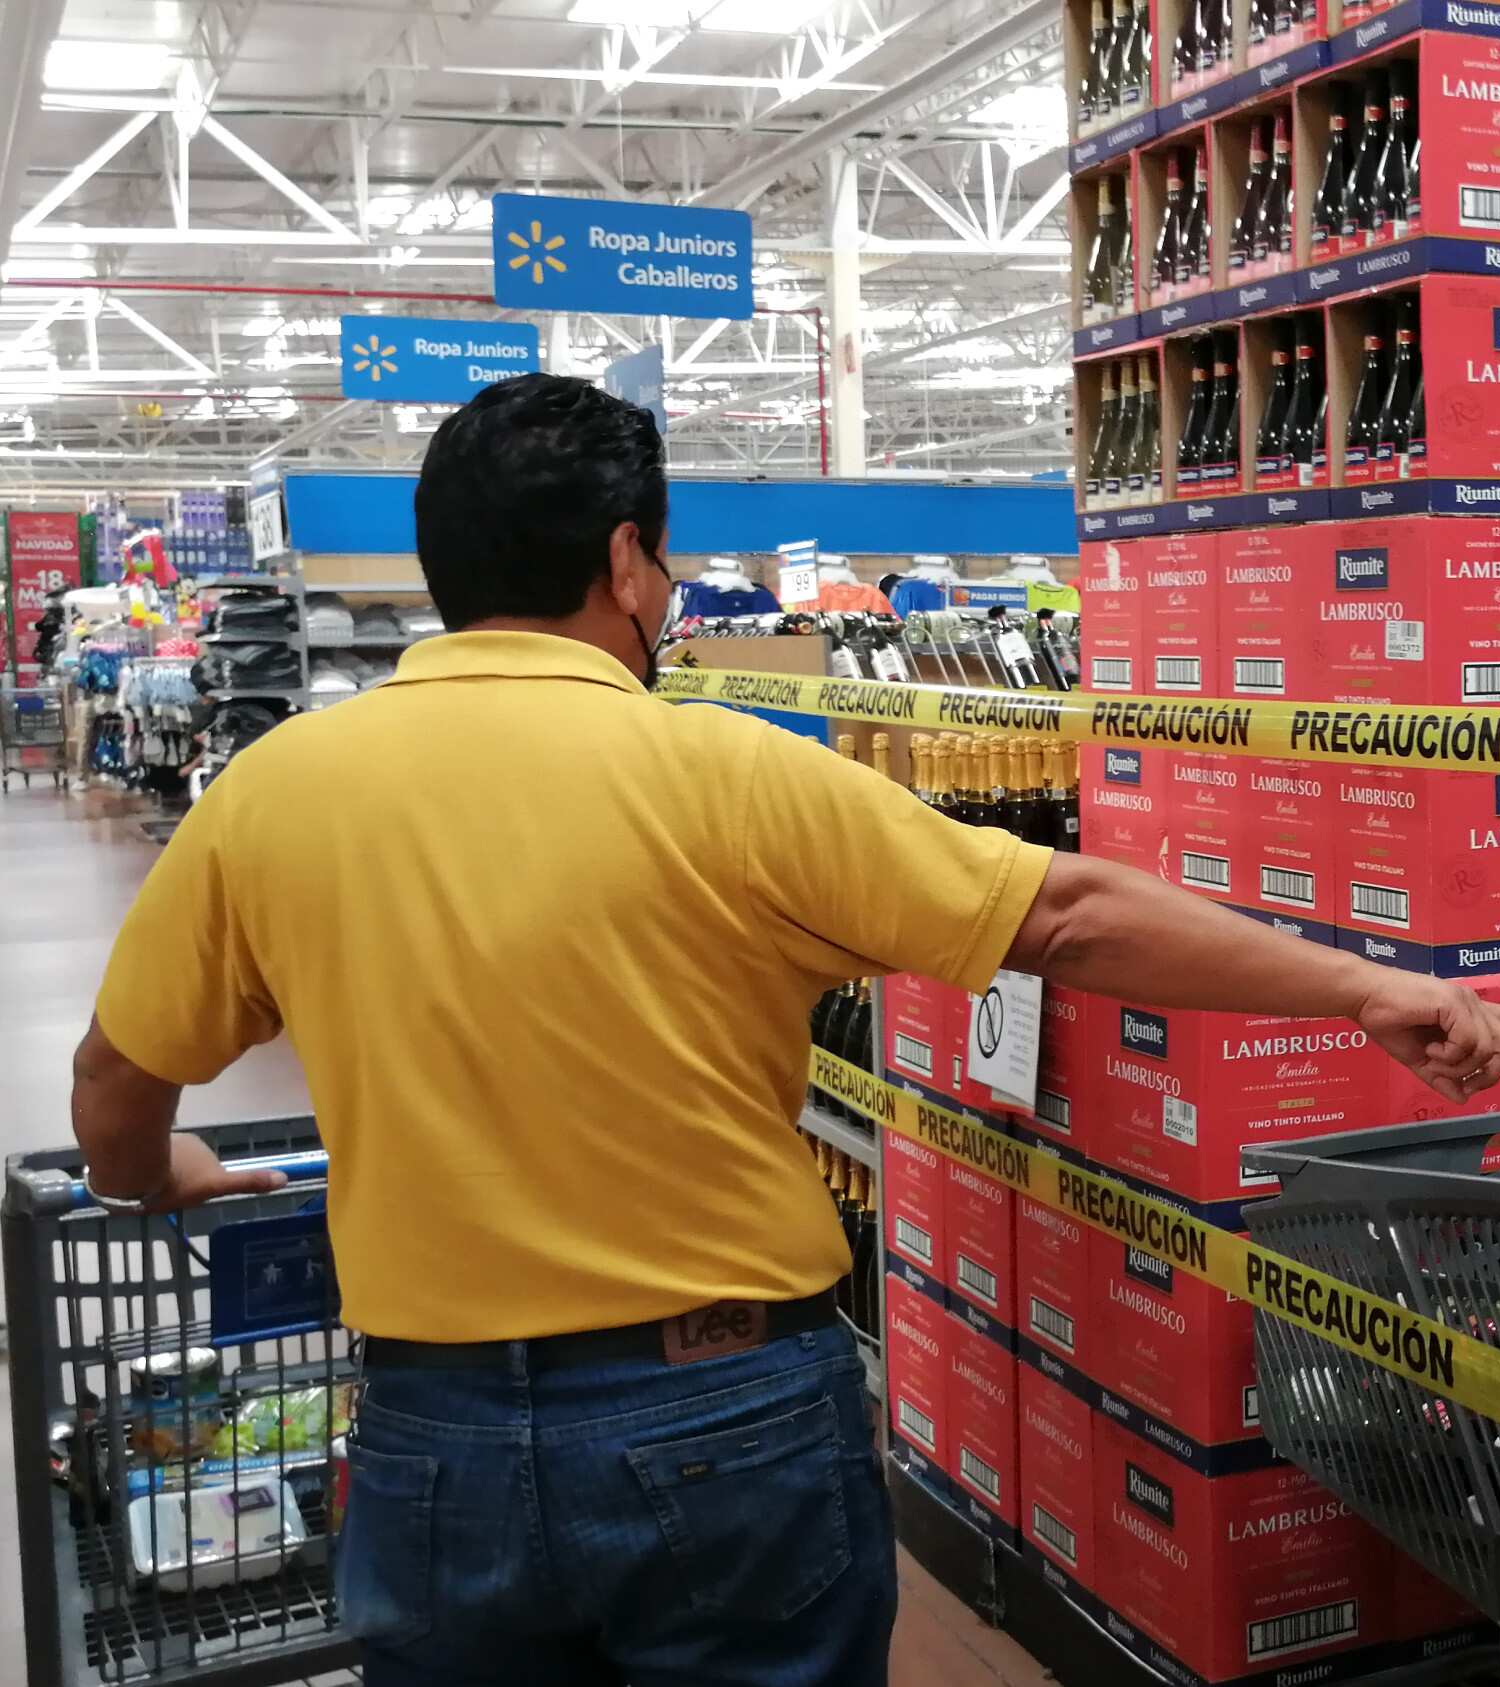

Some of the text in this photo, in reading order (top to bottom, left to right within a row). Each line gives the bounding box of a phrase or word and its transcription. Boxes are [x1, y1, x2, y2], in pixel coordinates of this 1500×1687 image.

[1467, 162, 1489, 173] VINO
[589, 226, 737, 258] Ropa Juniors
[1357, 251, 1411, 275] LAMBRUSCO
[618, 263, 739, 292] Caballeros
[415, 338, 529, 360] Ropa Juniors
[1361, 490, 1395, 510] Riunite
[15, 540, 73, 551] NAVIDAD
[37, 570, 63, 588] 18
[1147, 570, 1207, 588] LAMBRUSCO
[1226, 566, 1292, 584] LAMBRUSCO
[1340, 556, 1384, 581] Riunite
[1320, 601, 1404, 622] LAMBRUSCO
[1469, 640, 1490, 648] VINO
[1092, 701, 1252, 747] PRECAUCIÓN
[1107, 752, 1139, 775] Riunite
[1174, 764, 1237, 788] LAMBRUSCO
[1251, 773, 1321, 797] LAMBRUSCO
[1341, 784, 1415, 809] LAMBRUSCO
[1094, 788, 1152, 813] LAMBRUSCO
[1365, 939, 1396, 960] Riunite
[1124, 1014, 1164, 1044] Riunite
[1223, 1030, 1367, 1060] LAMBRUSCO
[1106, 1055, 1181, 1097] LAMBRUSCO
[1276, 1060, 1319, 1079] Emilia
[1248, 1112, 1345, 1129] VINO TINTO ITALIANO
[889, 1132, 937, 1169] LAMBRUSCO
[951, 1165, 1002, 1205] LAMBRUSCO
[816, 1053, 897, 1123] PRECAUCIÓN
[918, 1105, 1030, 1189] PRECAUCIÓN
[1058, 1169, 1208, 1272] PRECAUCIÓN
[1248, 1252, 1454, 1388] PRECAUCIÓN
[1022, 1200, 1080, 1243] LAMBRUSCO
[1109, 1279, 1186, 1335] LAMBRUSCO
[679, 1307, 753, 1351] Lee
[892, 1312, 938, 1357] LAMBRUSCO
[952, 1355, 1005, 1405] LAMBRUSCO
[1102, 1392, 1129, 1420] Riunite
[1025, 1406, 1082, 1460] LAMBRUSCO
[1145, 1420, 1191, 1458] LAMBRUSCO
[1129, 1468, 1169, 1506] Riunite
[1228, 1500, 1352, 1542] LAMBRUSC
[1113, 1501, 1188, 1571] LAMBRUSCO
[1280, 1532, 1322, 1554] Emilia
[1280, 1586, 1306, 1601] TINTO
[1308, 1577, 1350, 1594] ITALIANO
[1423, 1633, 1475, 1656] Riunite
[1276, 1664, 1333, 1687] Riunite
